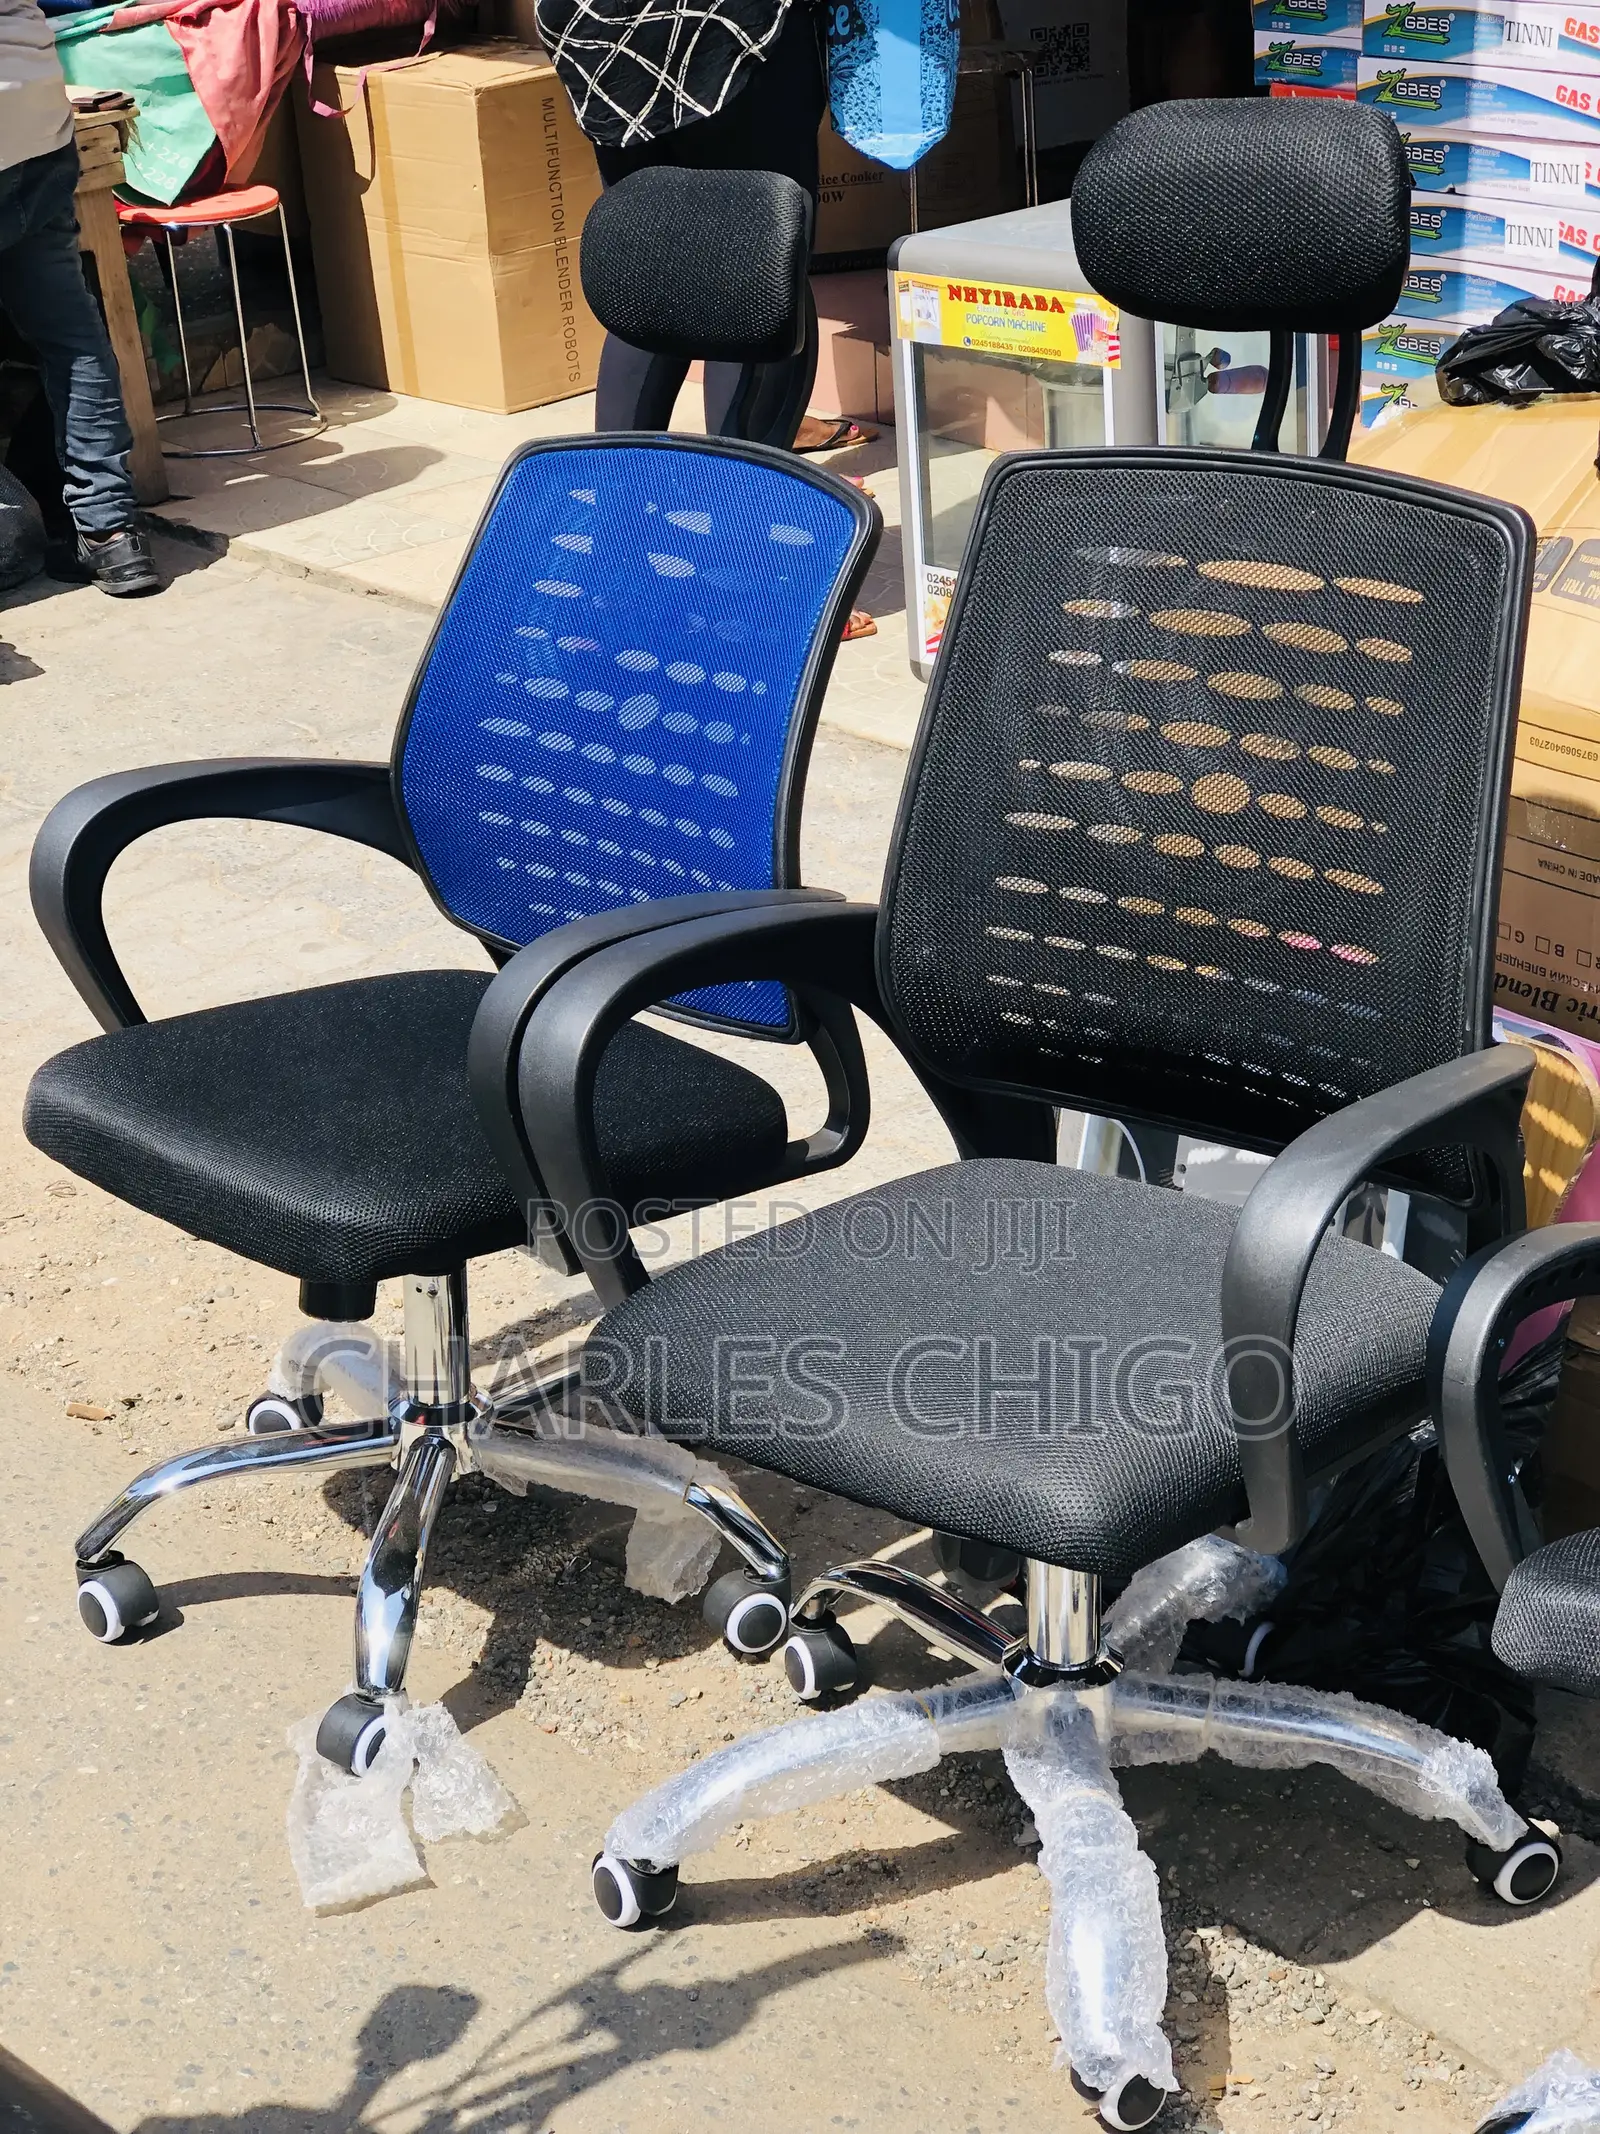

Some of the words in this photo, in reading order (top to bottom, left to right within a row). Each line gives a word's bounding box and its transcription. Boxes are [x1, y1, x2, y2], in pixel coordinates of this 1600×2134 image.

[1505, 19, 1553, 48] TINNI
[1564, 17, 1600, 44] GAS
[1556, 84, 1591, 111] GAS
[542, 97, 565, 233] MULTIFUNCTION
[1531, 161, 1580, 185] TINNI
[817, 174, 838, 186] ice
[842, 170, 884, 184] Cooker
[1506, 224, 1554, 249] TINNI
[554, 236, 573, 312] BLENDER
[947, 284, 1065, 314] NHYIRABA
[966, 313, 1005, 328] POPCORN
[1007, 318, 1047, 333] MACHINE
[562, 315, 581, 382] ROBOTS
[1529, 736, 1599, 762] 6975069402703
[1537, 858, 1566, 875] CHINA
[1567, 867, 1578, 879] IN
[1579, 869, 1600, 884] ADE
[1514, 930, 1525, 944] G
